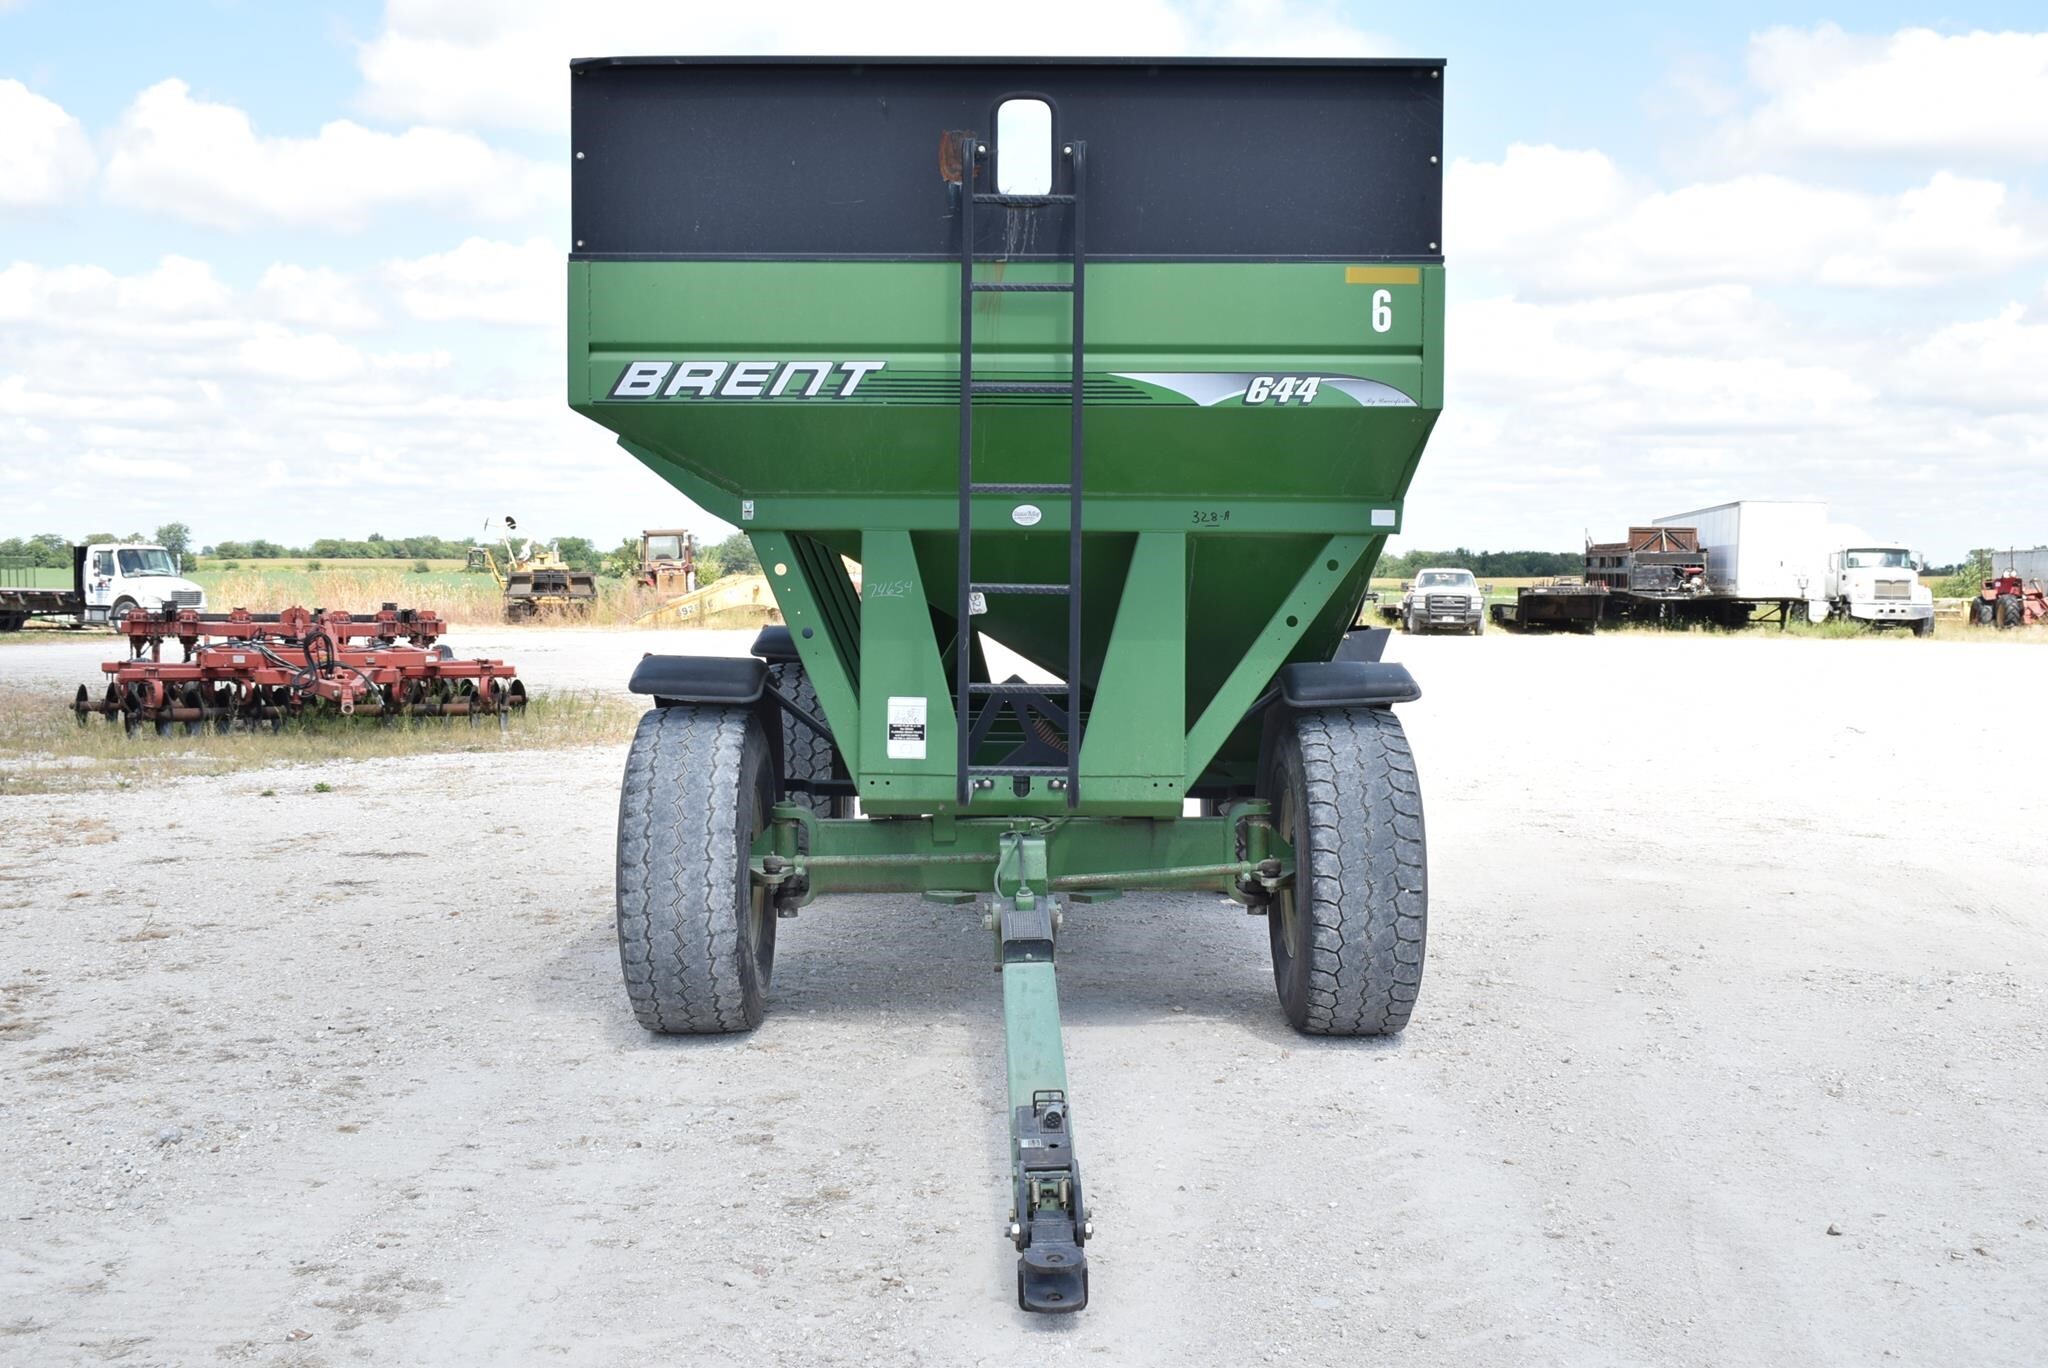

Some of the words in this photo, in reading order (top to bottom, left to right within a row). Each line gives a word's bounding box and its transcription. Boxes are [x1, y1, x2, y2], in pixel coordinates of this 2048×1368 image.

[1372, 289, 1391, 332] 6
[607, 361, 888, 399] BRENT
[1243, 376, 1320, 404] 644
